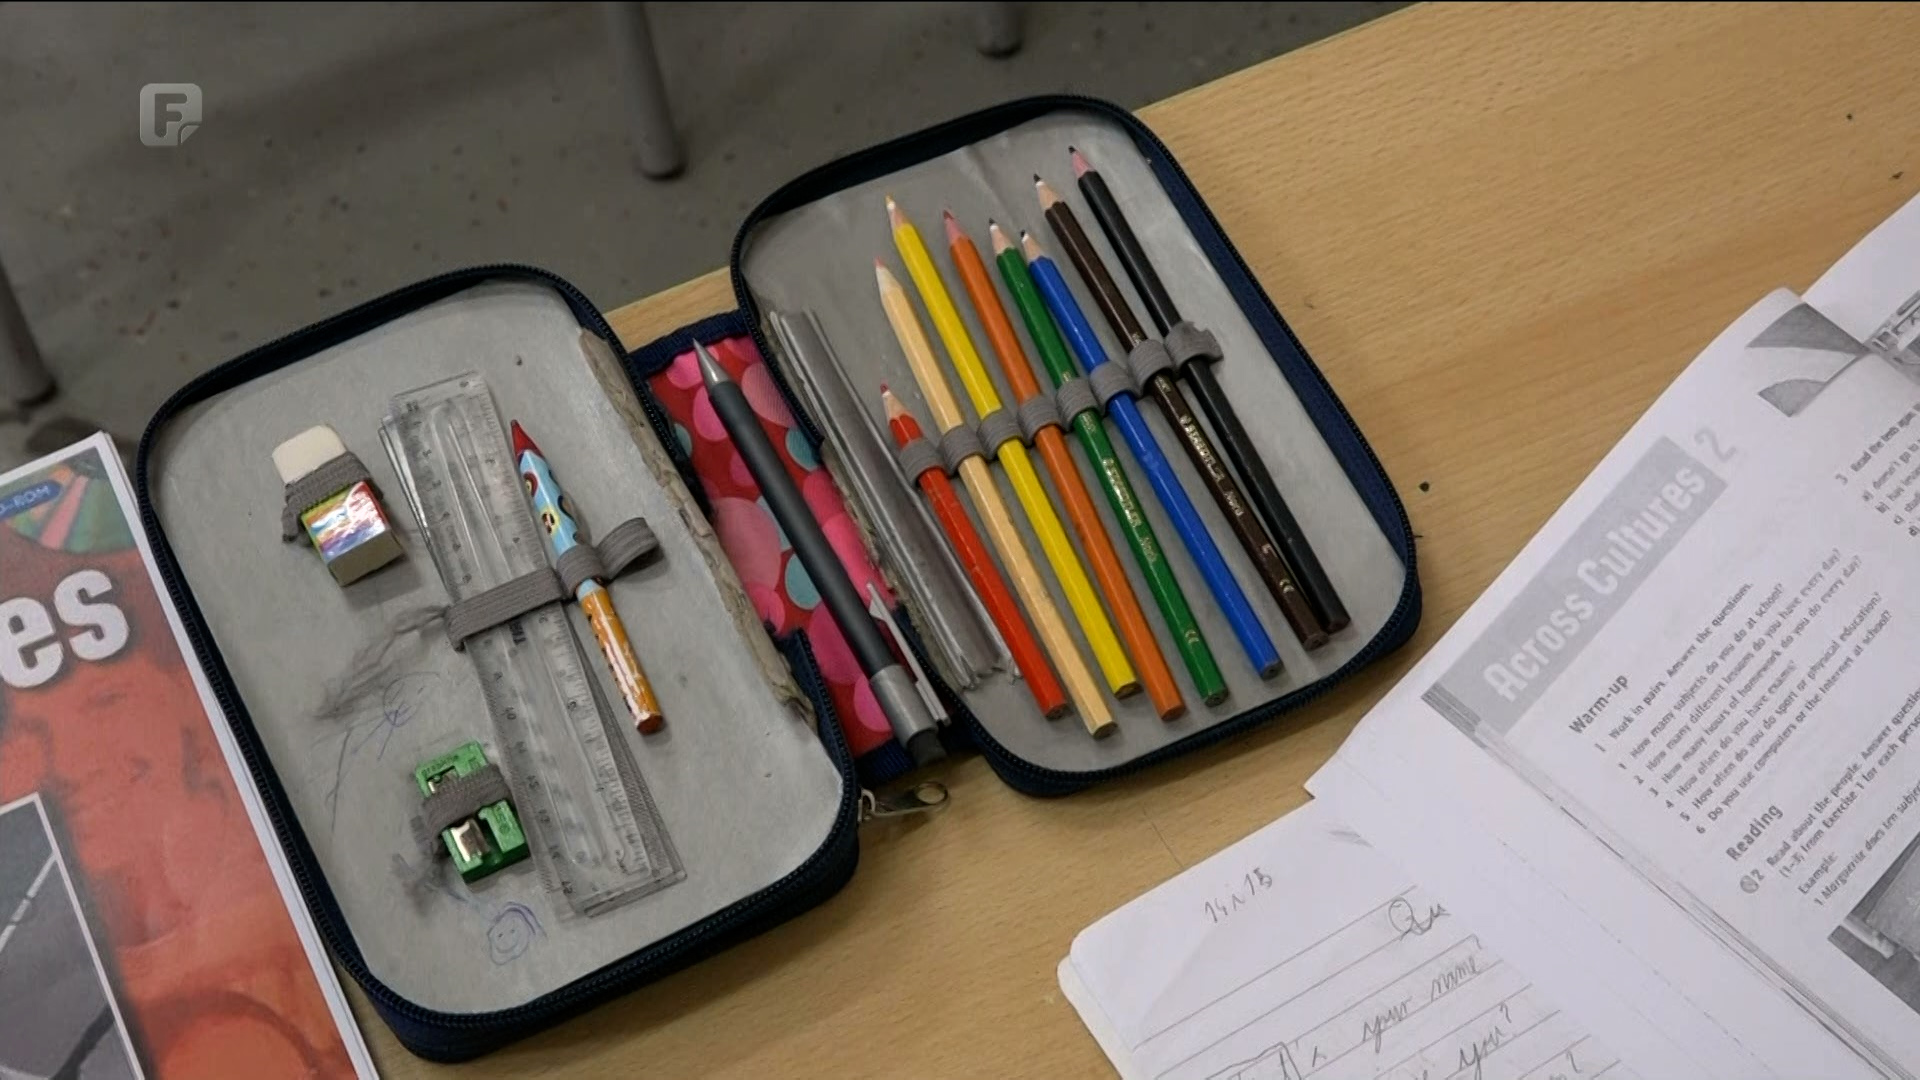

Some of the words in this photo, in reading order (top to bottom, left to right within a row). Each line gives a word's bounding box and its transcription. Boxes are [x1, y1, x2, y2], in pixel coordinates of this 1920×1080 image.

[1483, 593, 1594, 700] Across
[1577, 468, 1704, 594] Cultures
[1693, 426, 1739, 463] 2
[0, 569, 130, 689] es
[1751, 637, 1766, 652] do
[1763, 619, 1782, 638] you
[1780, 634, 1794, 648] do
[1792, 616, 1810, 636] you
[1807, 602, 1821, 617] do
[1705, 660, 1719, 675] do
[1717, 643, 1735, 661] you
[1733, 628, 1747, 643] do
[1568, 675, 1628, 733] Warm-up
[1608, 715, 1634, 739] Work
[1631, 704, 1644, 715] in
[1694, 626, 1712, 644] the
[1718, 735, 1733, 750] do
[1731, 717, 1749, 736] you
[1744, 694, 1768, 718] have
[1734, 747, 1748, 762] do
[1746, 729, 1764, 748] you
[1761, 714, 1776, 730] do
[1706, 806, 1723, 821] Do
[1720, 787, 1740, 807] you
[1790, 812, 1816, 842] about
[1813, 796, 1830, 813] the
[1725, 805, 1783, 860] Reading
